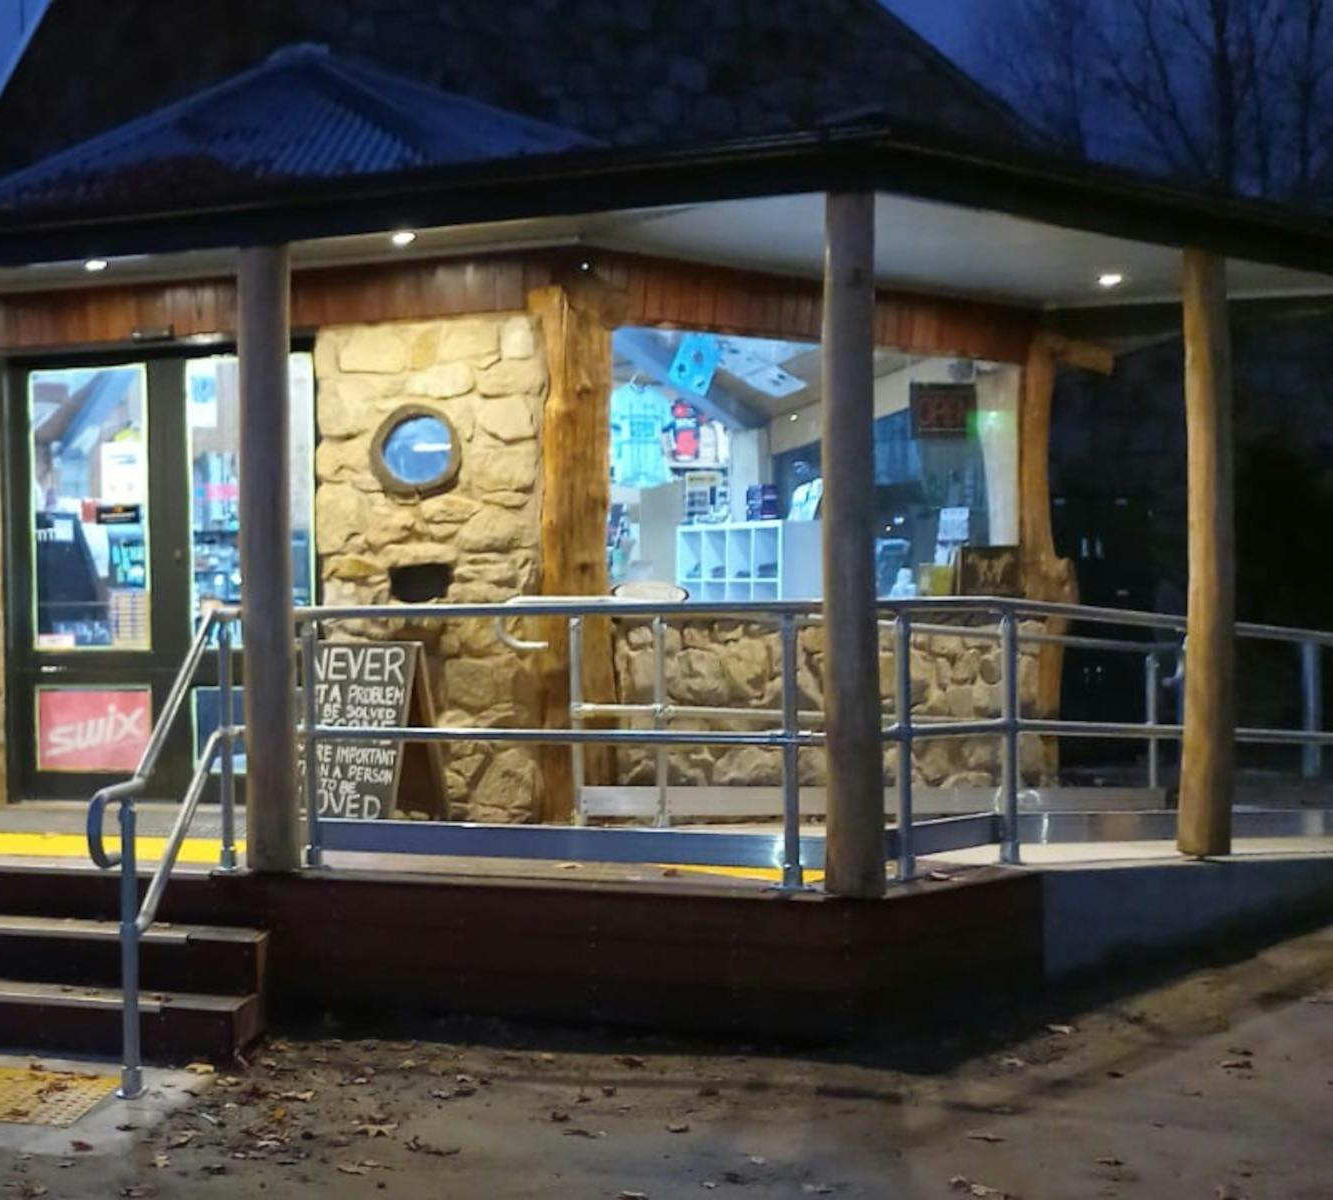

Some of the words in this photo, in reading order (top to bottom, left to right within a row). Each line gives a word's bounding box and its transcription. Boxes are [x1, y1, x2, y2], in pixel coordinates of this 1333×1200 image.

[314, 646, 405, 685] NEVER
[348, 684, 405, 706] PROBLEM
[324, 703, 341, 719] BE
[346, 705, 396, 720] SOLVED
[336, 746, 397, 765] IMPORTANT
[321, 777, 337, 791] TO
[347, 764, 393, 786] PERSON
